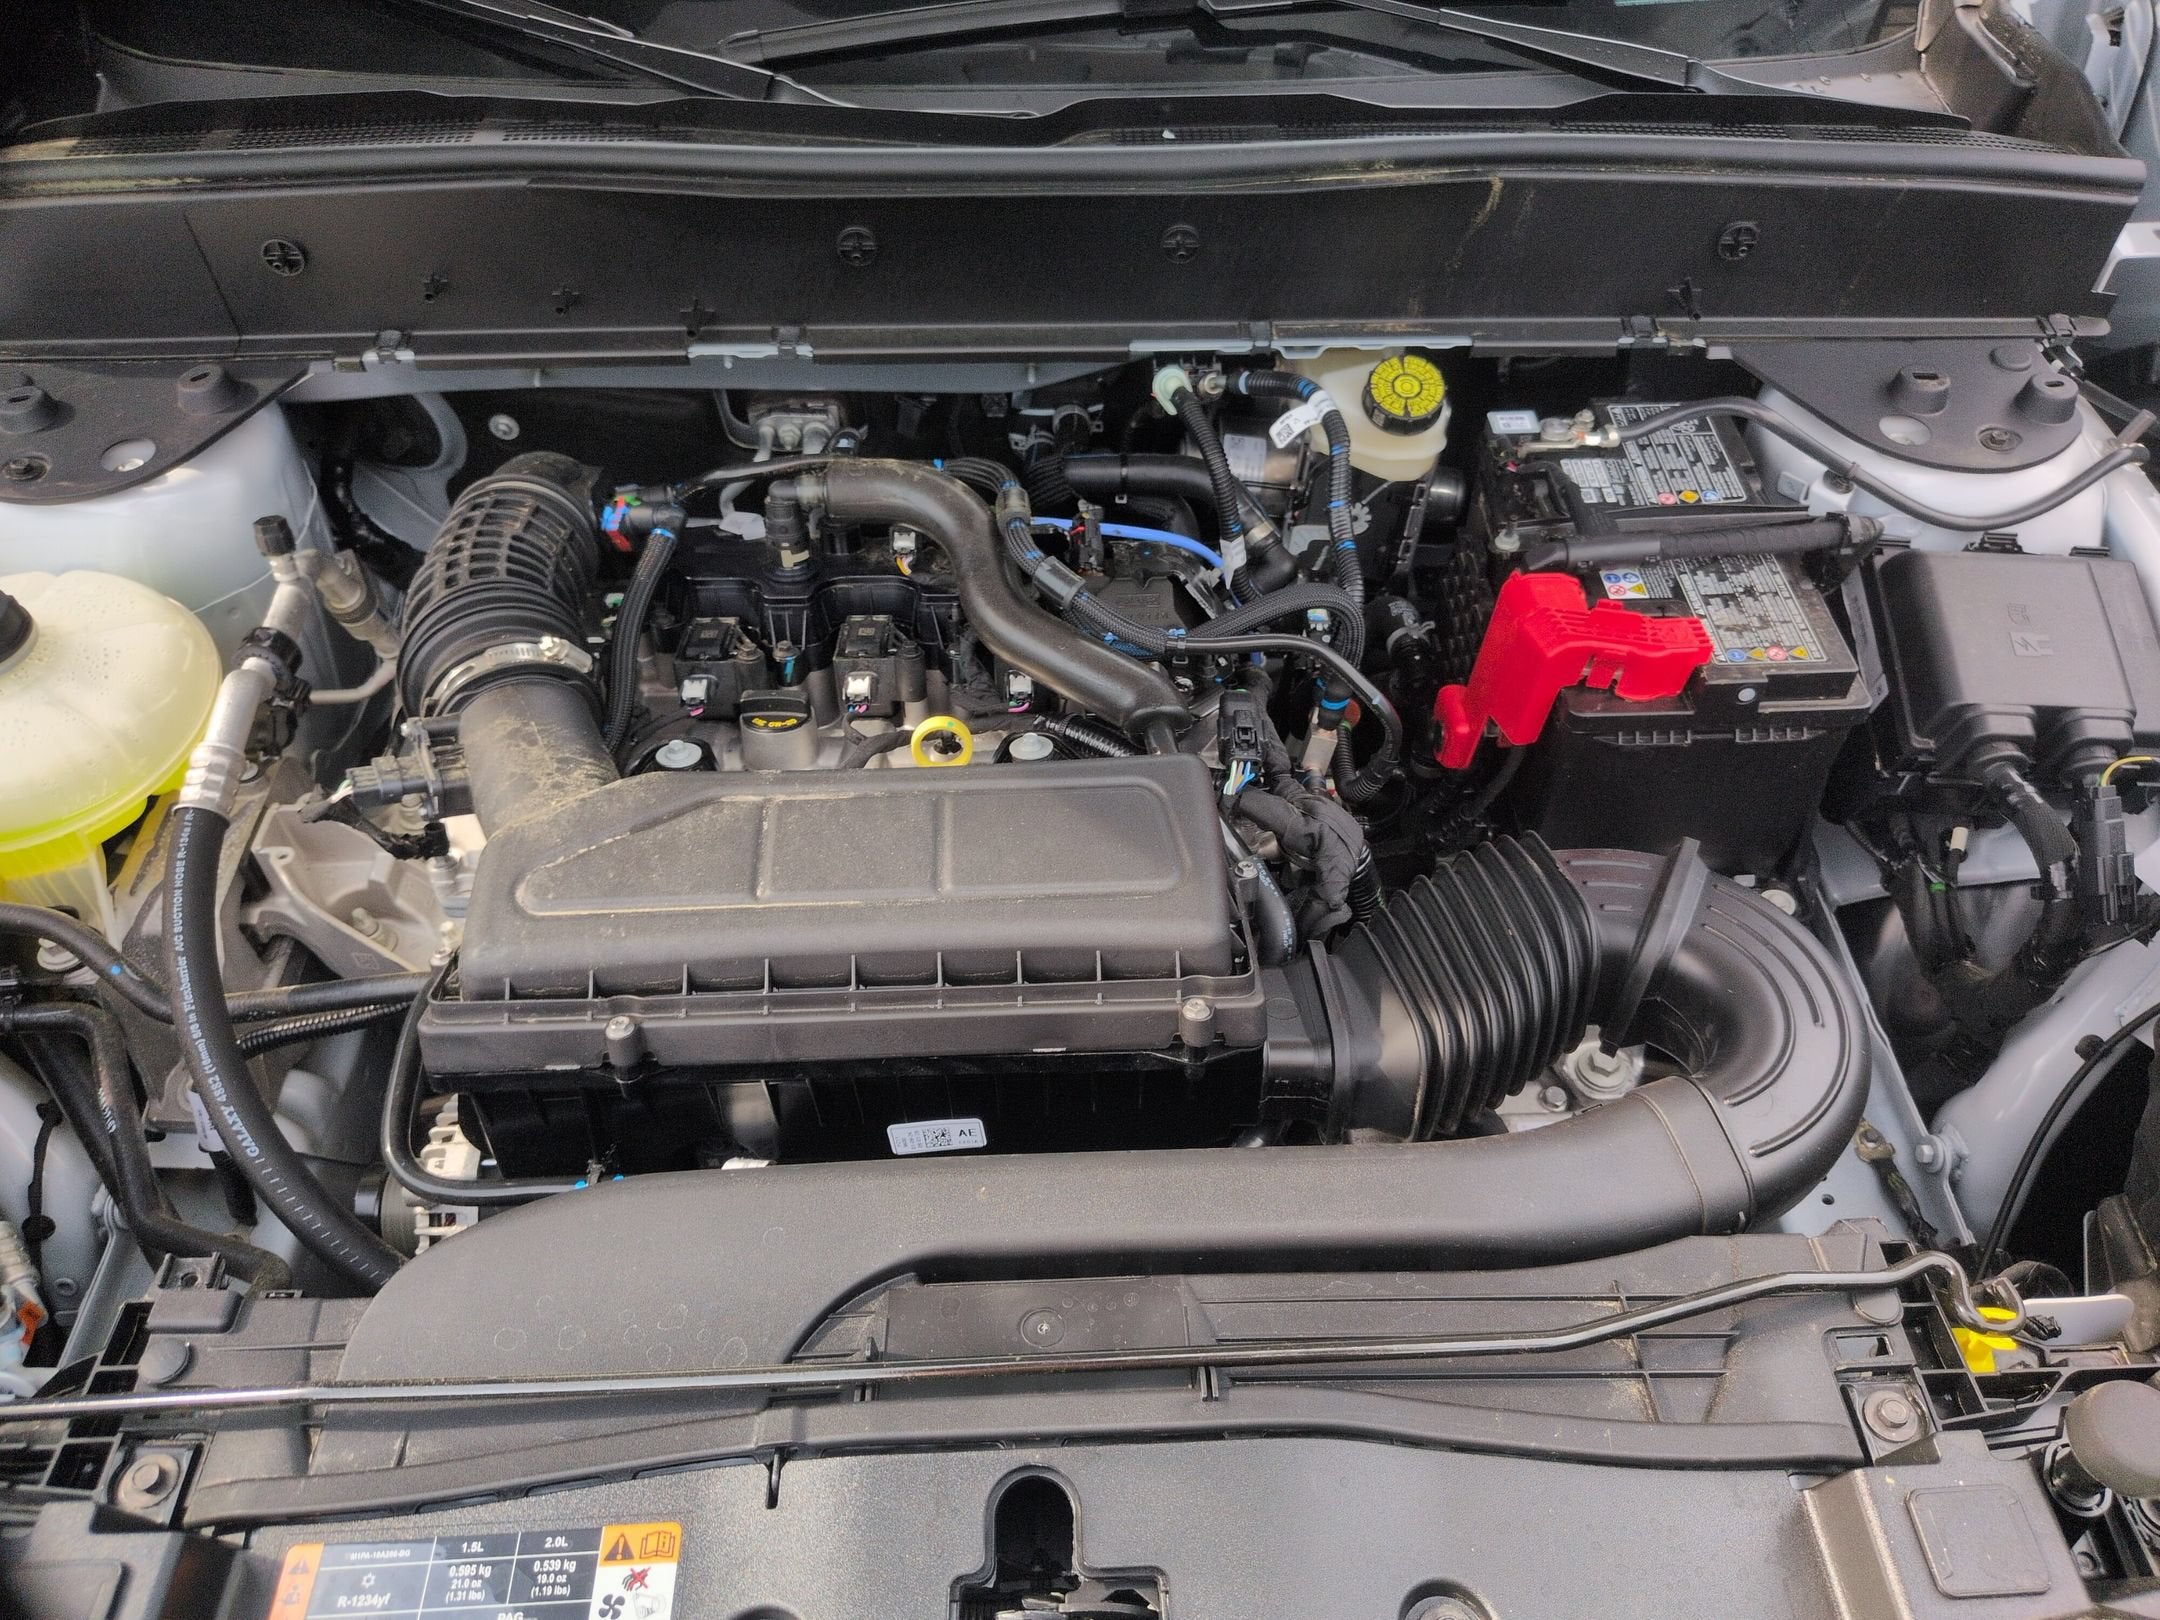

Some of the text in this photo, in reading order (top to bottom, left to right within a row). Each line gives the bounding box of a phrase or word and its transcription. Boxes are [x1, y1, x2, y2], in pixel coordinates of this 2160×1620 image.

[177, 827, 192, 859] R-134a
[174, 860, 186, 888] HOSE
[173, 888, 184, 933] SUCTION
[174, 934, 185, 952] A/C
[221, 1105, 260, 1157] GALAXY
[959, 1128, 977, 1137] AE
[461, 1541, 485, 1553] 1.5L
[544, 1536, 569, 1549] 2.0L
[449, 1563, 492, 1578] 0.595 kg
[533, 1559, 577, 1573] 0.539 kg
[451, 1578, 482, 1589] 21.0 oz
[537, 1573, 567, 1584] 19.0 oz
[445, 1589, 486, 1604] (1.31 lbs)
[530, 1584, 571, 1599] (1.19 lbs)
[337, 1593, 391, 1608] R-1234yf
